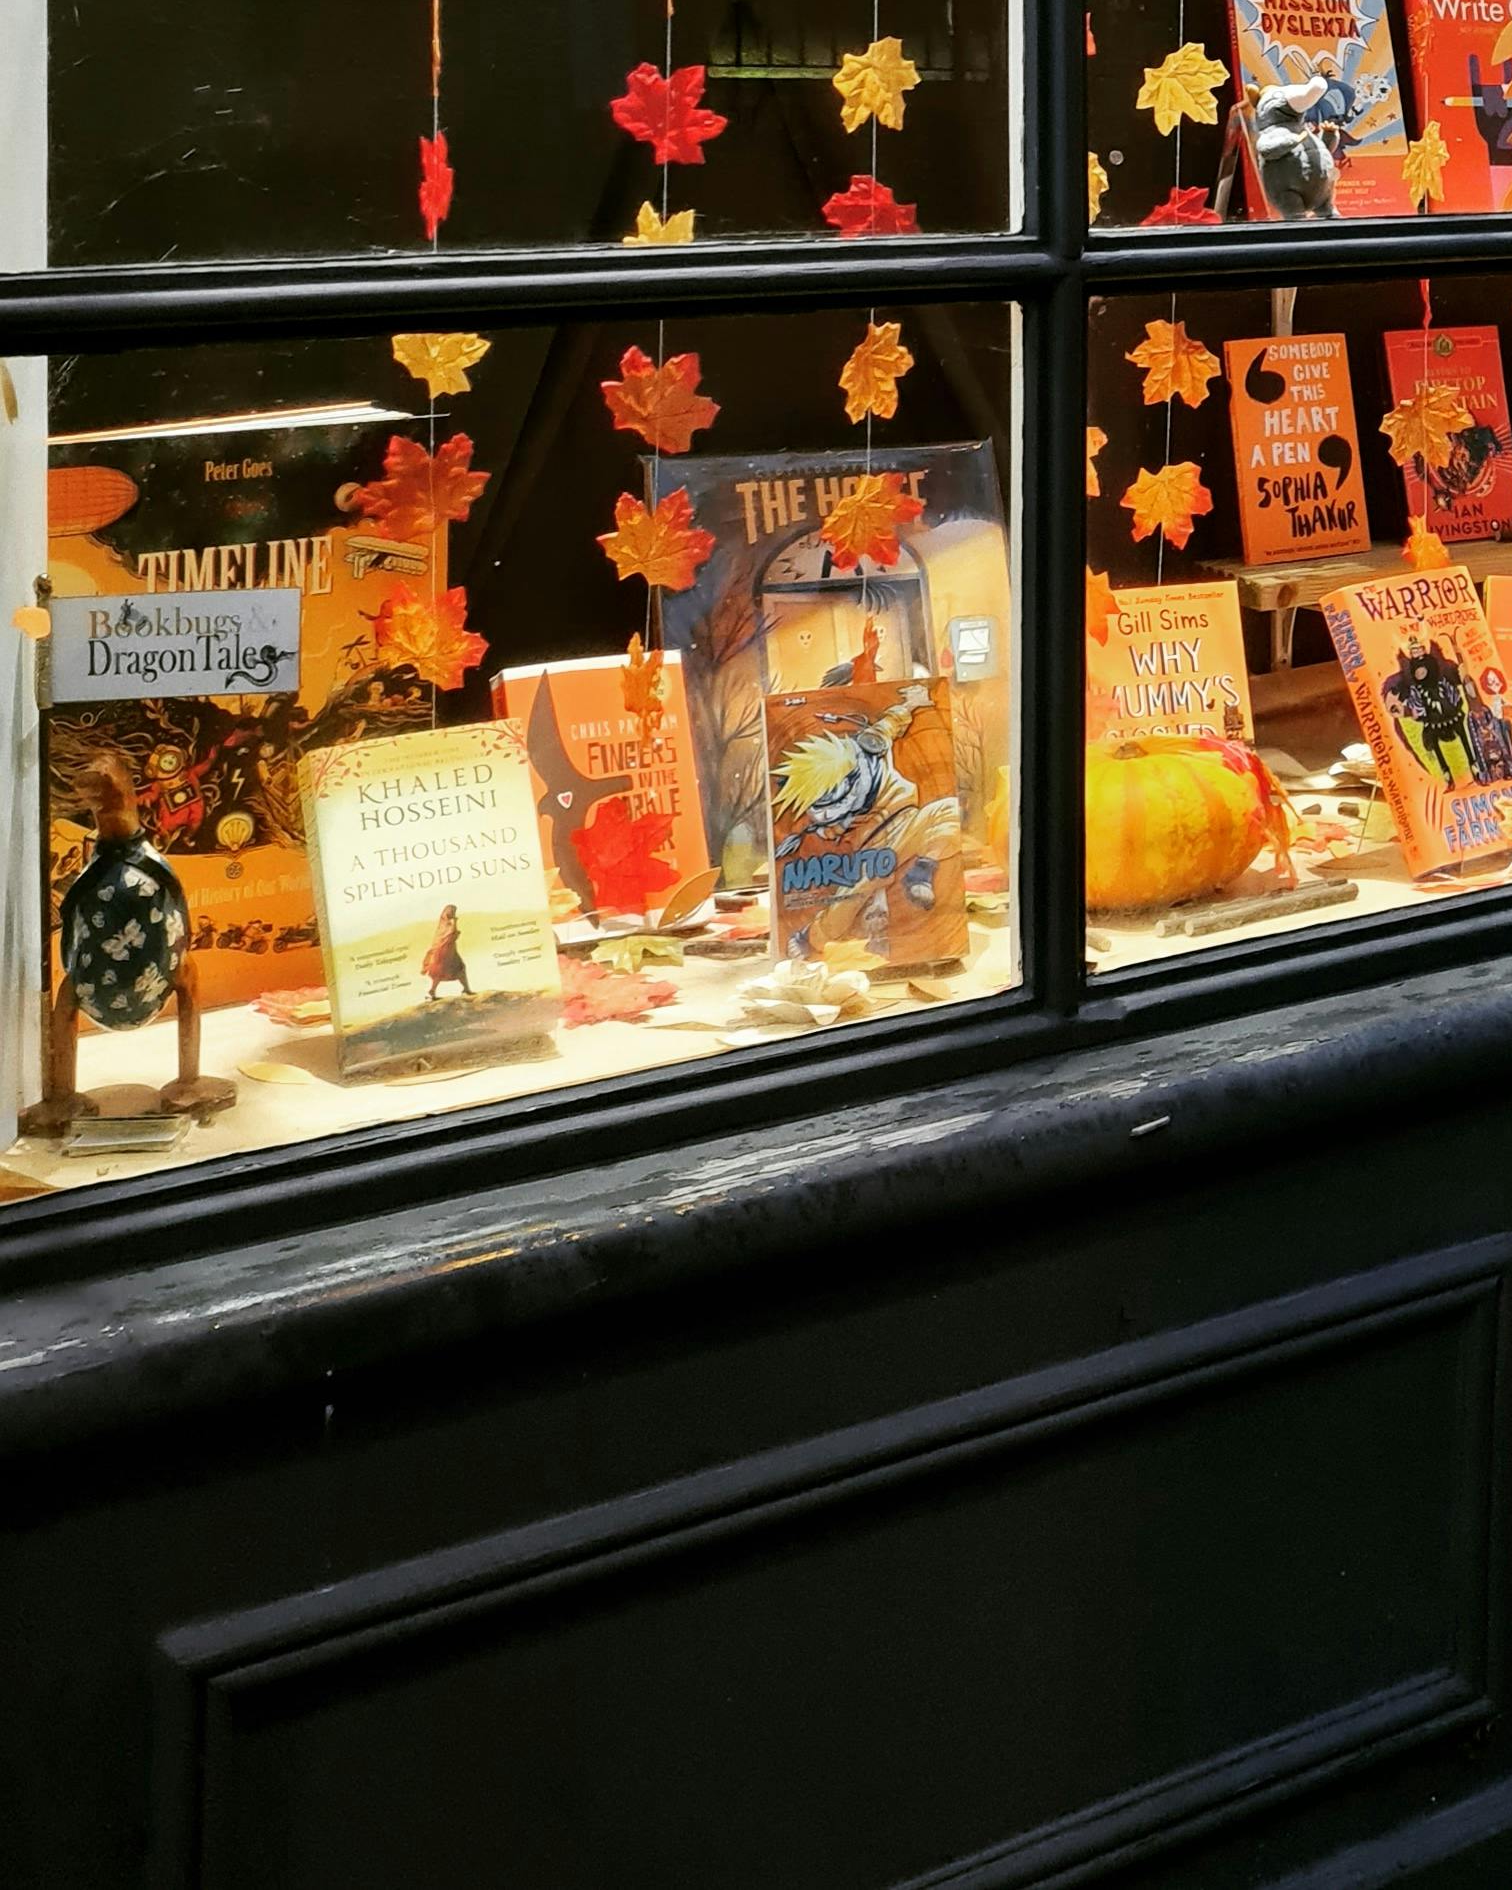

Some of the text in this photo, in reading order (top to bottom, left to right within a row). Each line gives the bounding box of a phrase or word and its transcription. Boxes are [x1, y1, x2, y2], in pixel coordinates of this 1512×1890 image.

[1261, 13, 1361, 39] DYSLEXIA
[1267, 341, 1341, 362] SOMEBODY
[1292, 362, 1330, 382] GIVE
[1290, 383, 1326, 403] THIS
[1264, 406, 1339, 438] HEART
[204, 458, 274, 482] Peter Goes
[1251, 441, 1311, 469] A PEN
[1257, 470, 1328, 508] SOPHIA
[735, 479, 807, 545] THE
[1285, 498, 1359, 538] THAKUR
[1454, 503, 1484, 519] IAN
[137, 535, 334, 596] TIMELINE
[1355, 574, 1476, 622] WARRIOR
[88, 606, 242, 640] Bookbugs
[1117, 609, 1209, 636] Gill Sims
[87, 639, 195, 683] Dragon
[1128, 637, 1202, 677] WHY
[570, 720, 611, 741] CHRIS
[1354, 683, 1392, 768] WARRIOR
[587, 736, 678, 775] FINGERS
[357, 763, 494, 804] KHALED
[360, 789, 498, 832] HOSSEINI
[350, 825, 518, 873] A THOUSAND
[343, 852, 532, 904] SPLENDID SUNS
[783, 846, 897, 894] NARUTO
